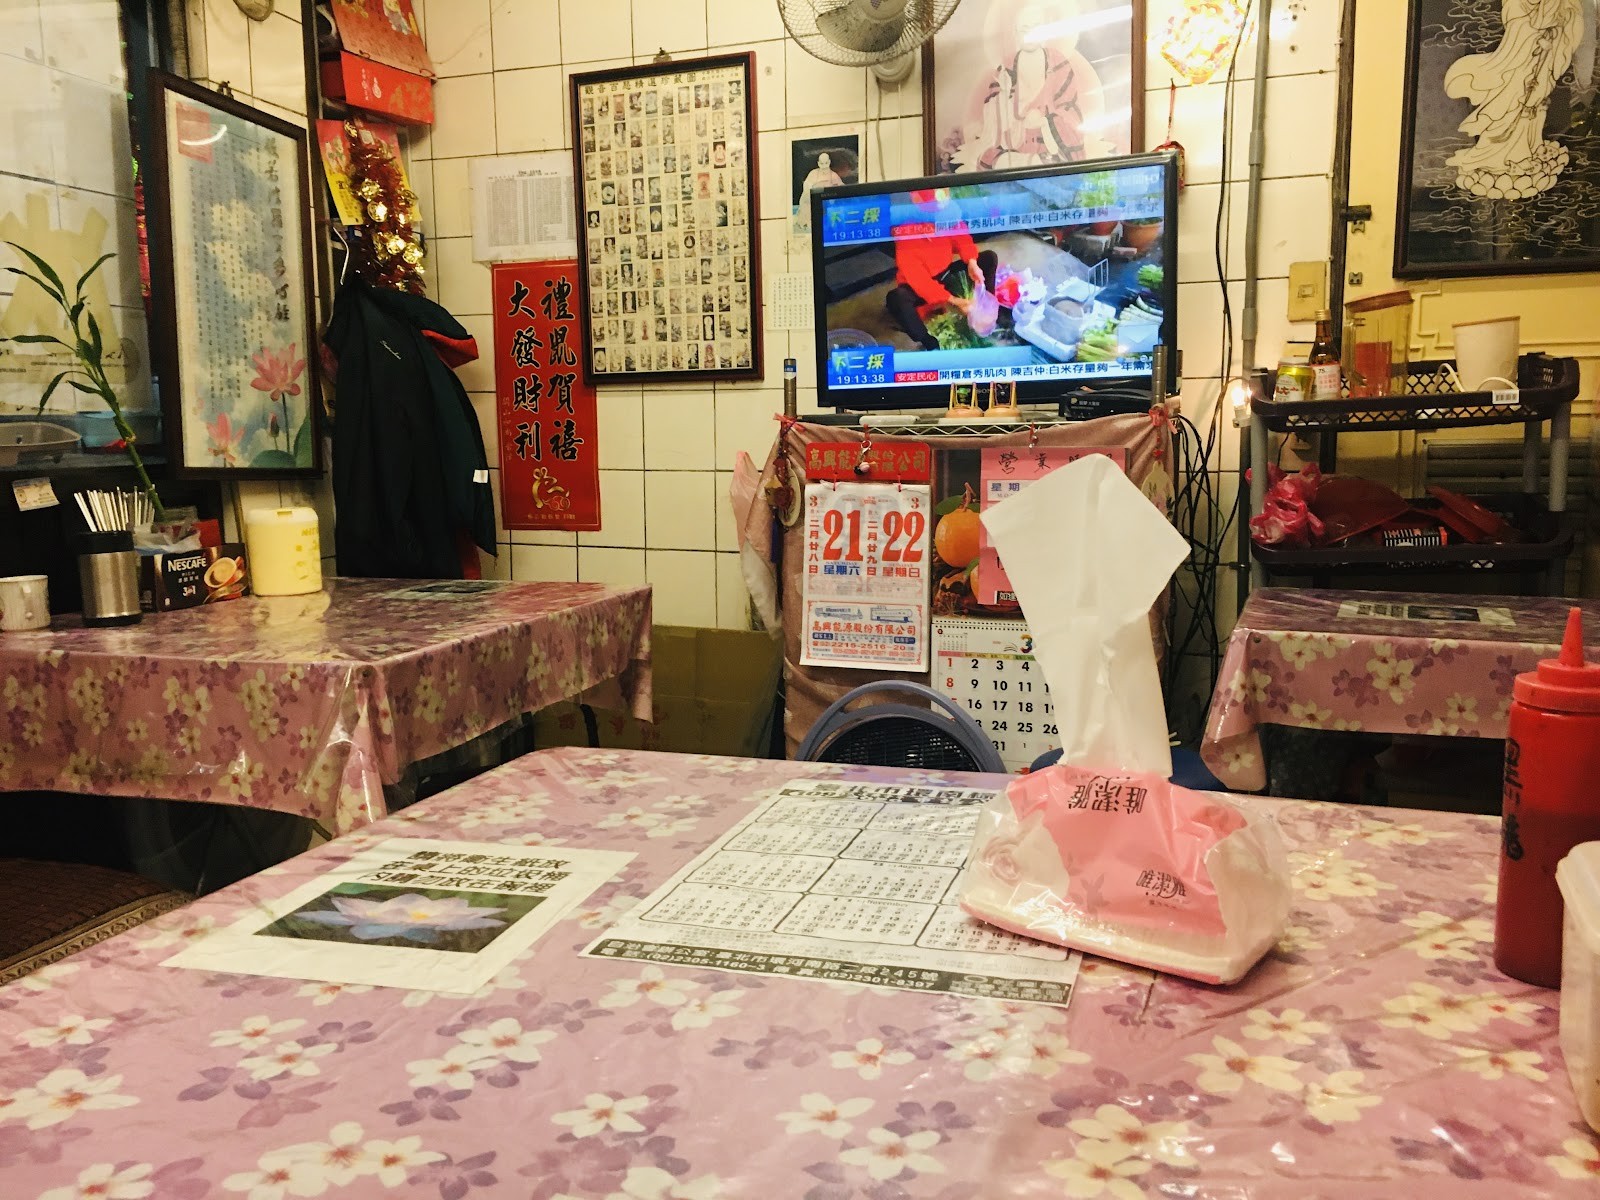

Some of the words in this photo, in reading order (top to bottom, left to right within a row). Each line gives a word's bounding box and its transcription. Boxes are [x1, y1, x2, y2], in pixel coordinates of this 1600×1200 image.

[507, 280, 544, 462] 大發財利
[896, 372, 937, 382] 安定民心
[939, 368, 1007, 381] 開糧倉秀肌肉
[837, 374, 885, 384] 19:13:38
[809, 496, 818, 507] 3
[911, 497, 920, 509] 3
[823, 509, 864, 562] 21
[881, 510, 926, 563] 22
[808, 519, 819, 574] 二月廿八日
[867, 521, 878, 576] 二月廿九日
[823, 565, 860, 576] 星期六
[882, 567, 920, 578] 星期日
[1020, 634, 1033, 654] 3
[947, 658, 953, 667] 1
[971, 659, 979, 669] 2
[996, 660, 1004, 670] 3
[1021, 662, 1030, 671] 4
[946, 677, 954, 688] 8
[971, 679, 979, 689] 9
[993, 680, 1008, 691] 10
[1018, 682, 1032, 692] 11
[967, 698, 982, 710] 16
[993, 700, 1008, 711] 17
[1018, 702, 1033, 713] 18
[992, 720, 1008, 731] 24
[1017, 722, 1033, 733] 25
[1043, 724, 1059, 735] 26
[408, 850, 572, 869] 請將衛生紙放
